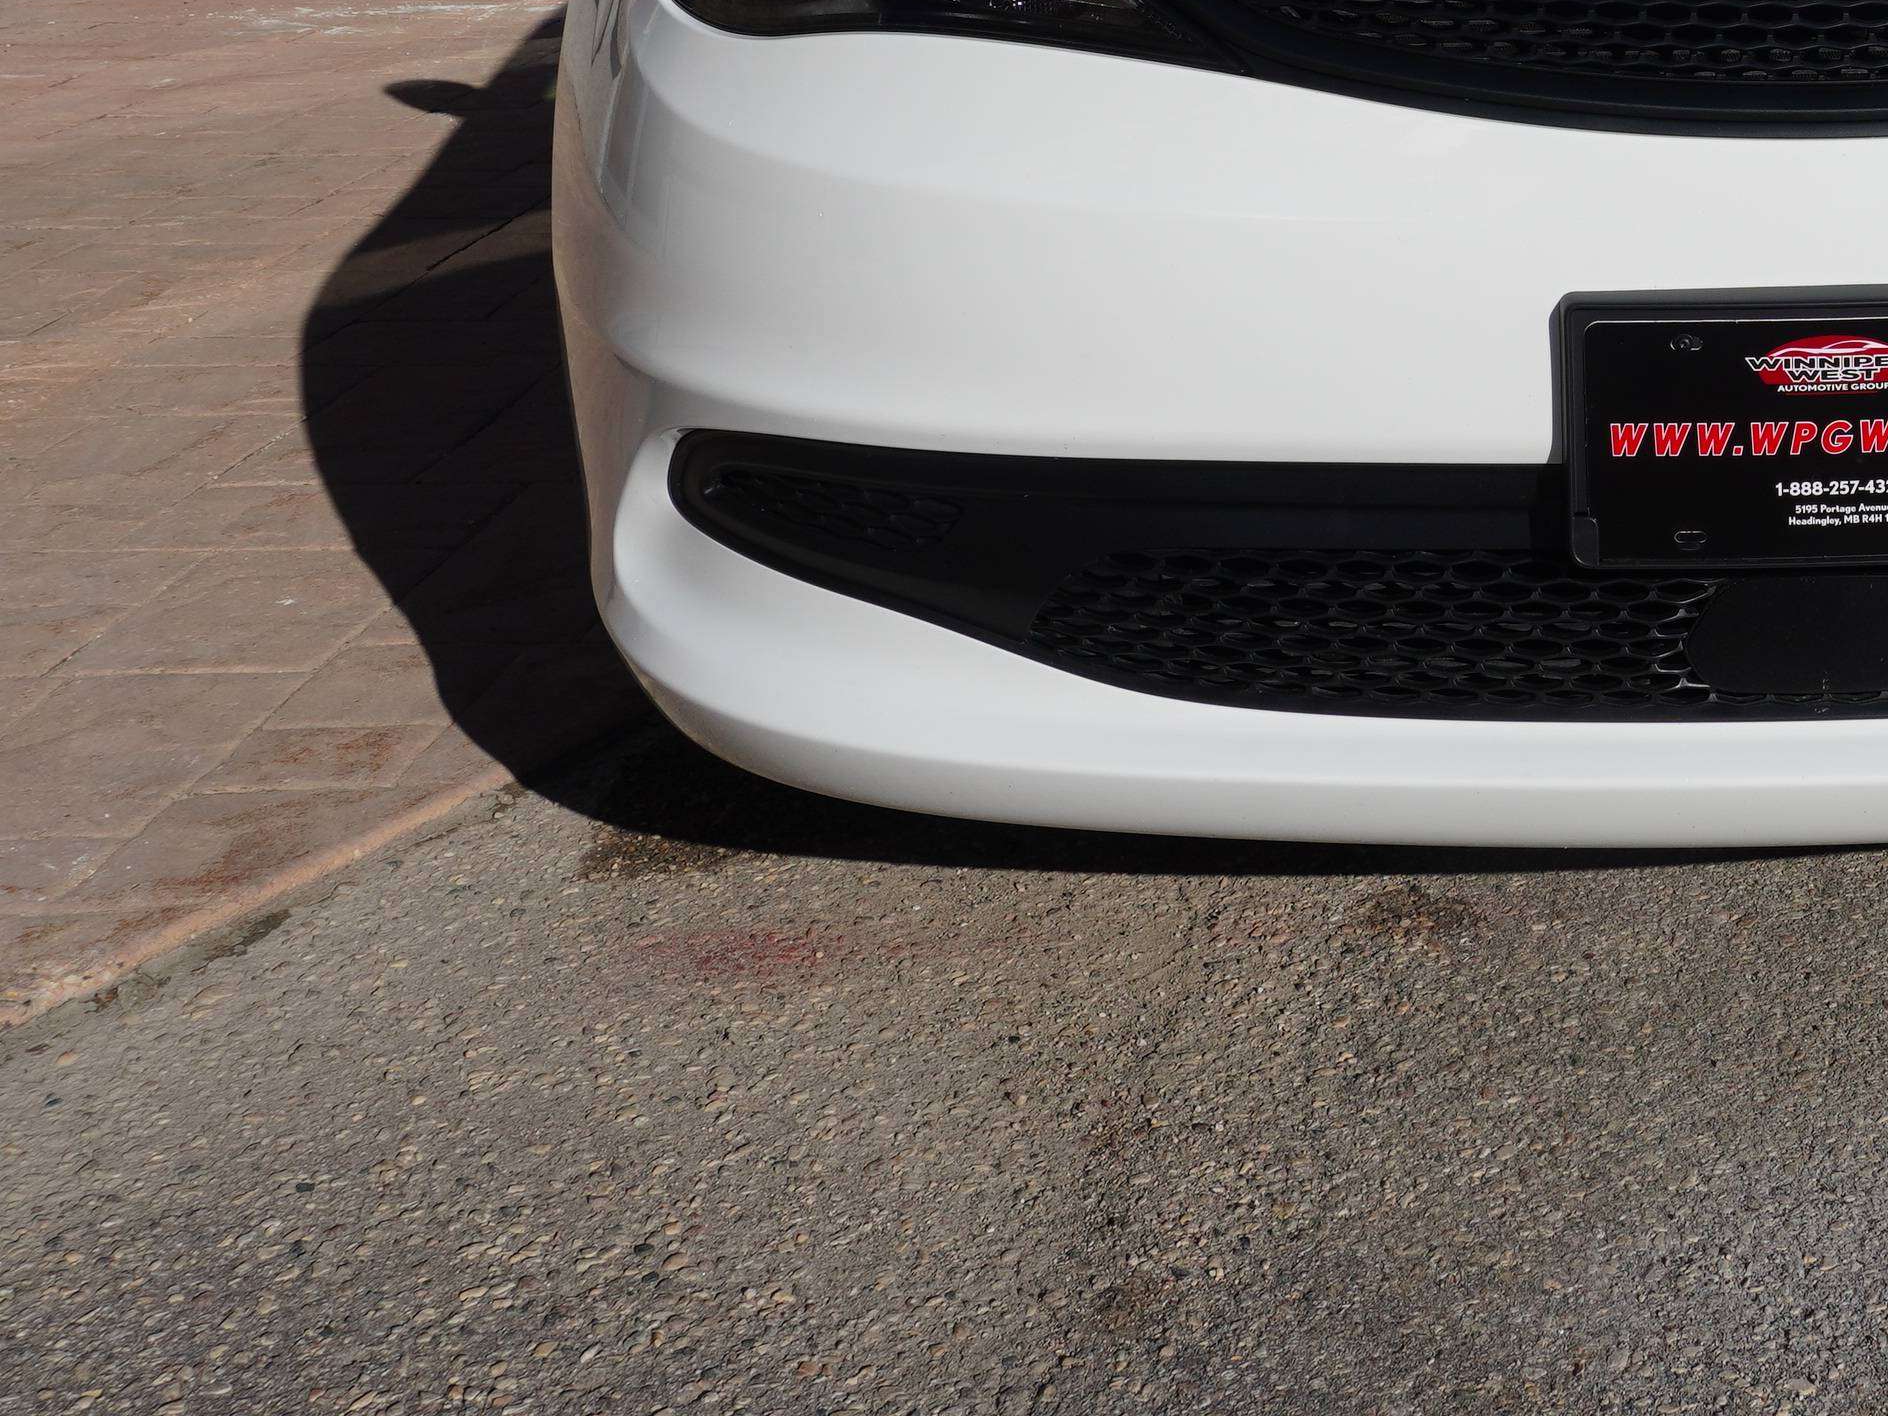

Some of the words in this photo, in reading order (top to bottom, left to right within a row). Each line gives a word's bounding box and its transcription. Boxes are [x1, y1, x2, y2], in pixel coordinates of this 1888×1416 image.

[1785, 368, 1881, 383] WEST
[1776, 383, 1849, 393] AUTOMOTIVE
[1795, 504, 1819, 514] 5195
[1820, 503, 1857, 515] Portage
[1788, 516, 1842, 527] Headingley,
[1843, 514, 1860, 524] MB
[1862, 513, 1883, 524] R4H
